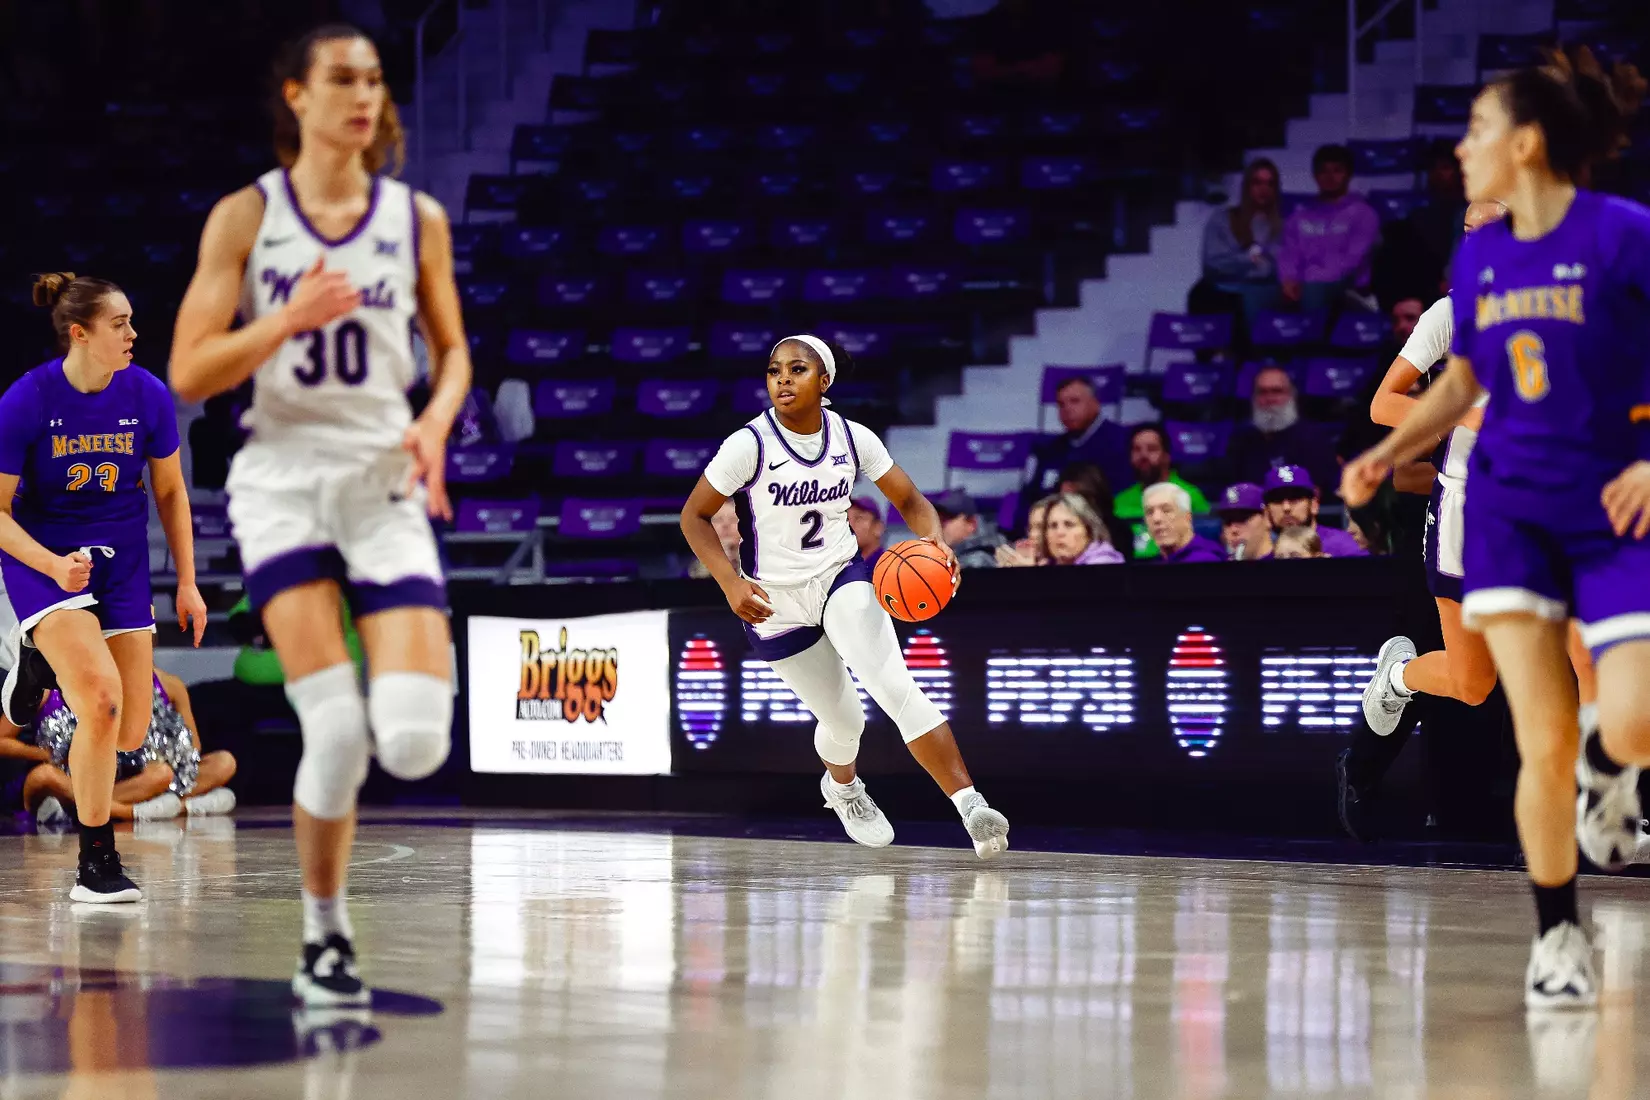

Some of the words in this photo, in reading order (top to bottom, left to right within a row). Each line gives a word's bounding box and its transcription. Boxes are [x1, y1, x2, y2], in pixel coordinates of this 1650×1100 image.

[292, 320, 367, 386] 30
[1506, 329, 1551, 404] 6
[66, 461, 119, 492] 23
[768, 476, 850, 507] Wildcats
[799, 509, 825, 551] 2
[517, 627, 618, 724] Briggs
[987, 648, 1133, 731] PEPSI
